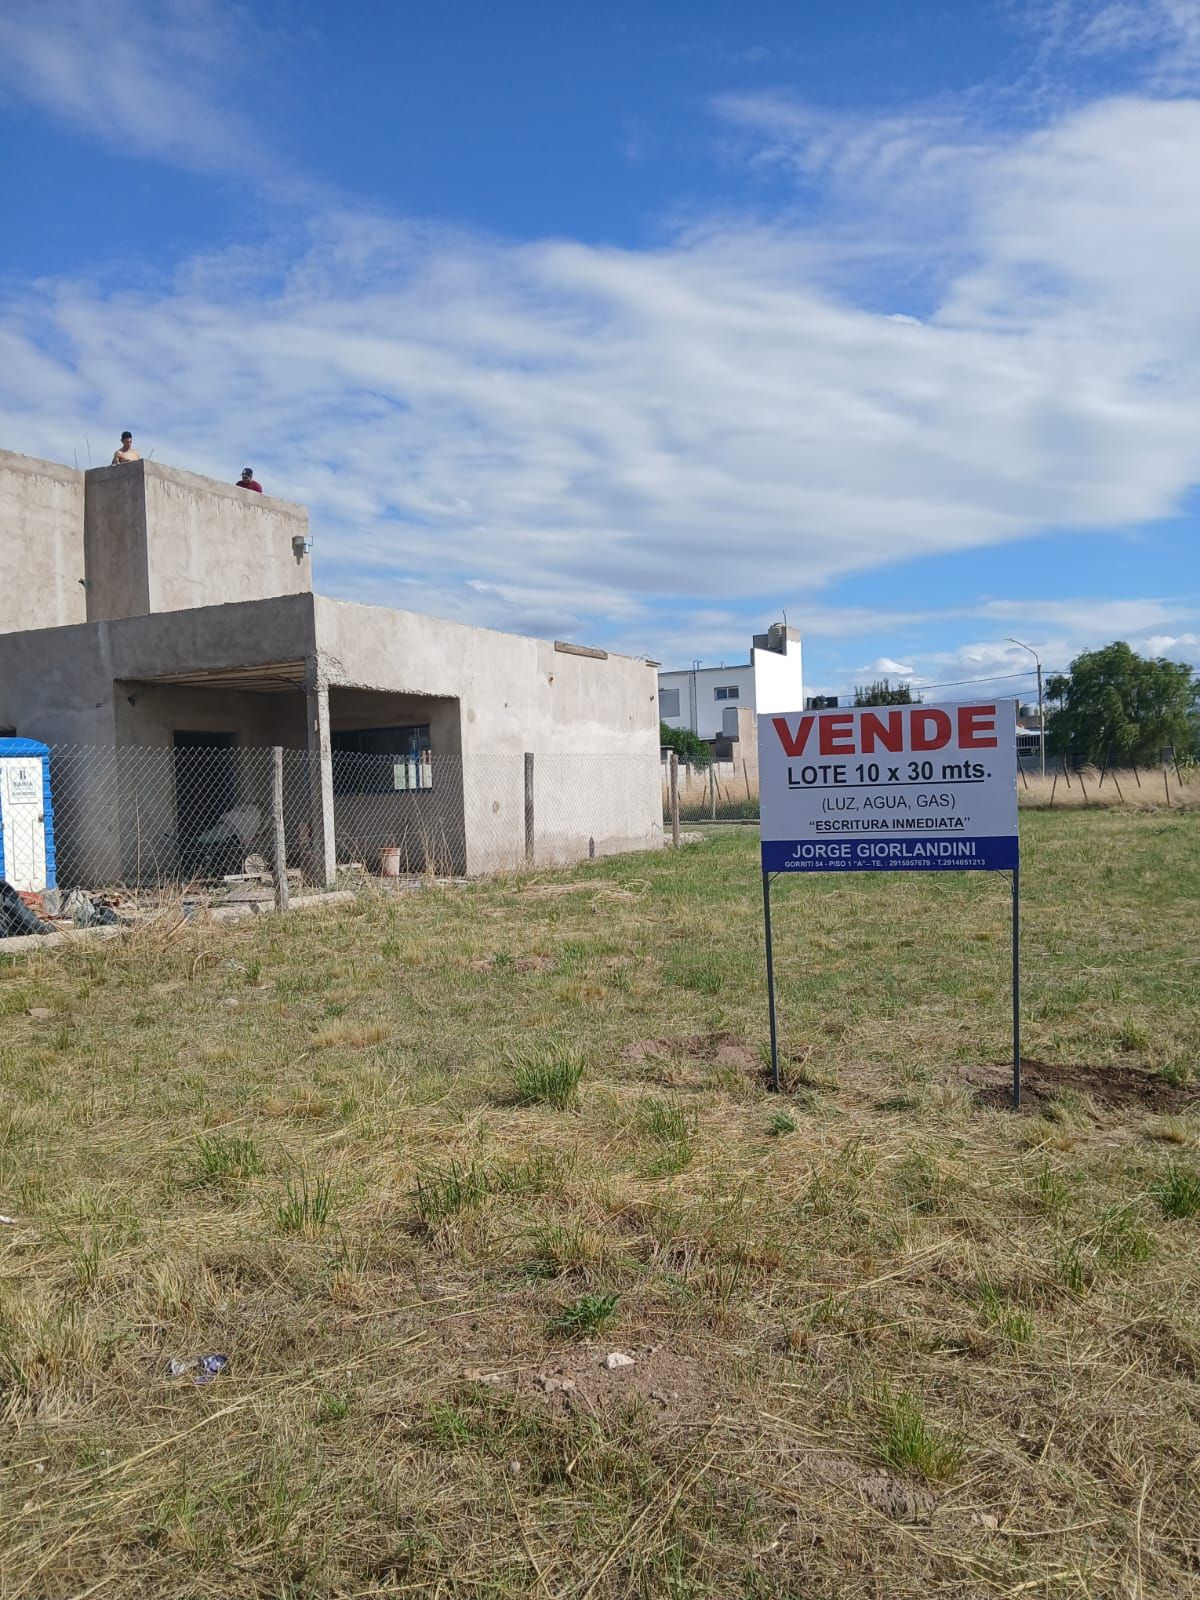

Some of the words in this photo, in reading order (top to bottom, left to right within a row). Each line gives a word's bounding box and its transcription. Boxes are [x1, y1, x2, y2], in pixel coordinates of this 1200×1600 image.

[771, 704, 998, 757] VENDE
[787, 764, 848, 785] LOTE
[855, 763, 880, 783] 10
[887, 767, 900, 781] x
[907, 761, 934, 781] 30
[942, 759, 992, 780] mts.
[822, 797, 860, 814] (LUZ,
[863, 794, 911, 811] AGUA,
[916, 793, 956, 810] GAS)
[792, 843, 852, 858] JORGE
[856, 841, 976, 857] GIORLANDINI
[784, 860, 814, 868] GORRITI
[815, 860, 823, 868] 54
